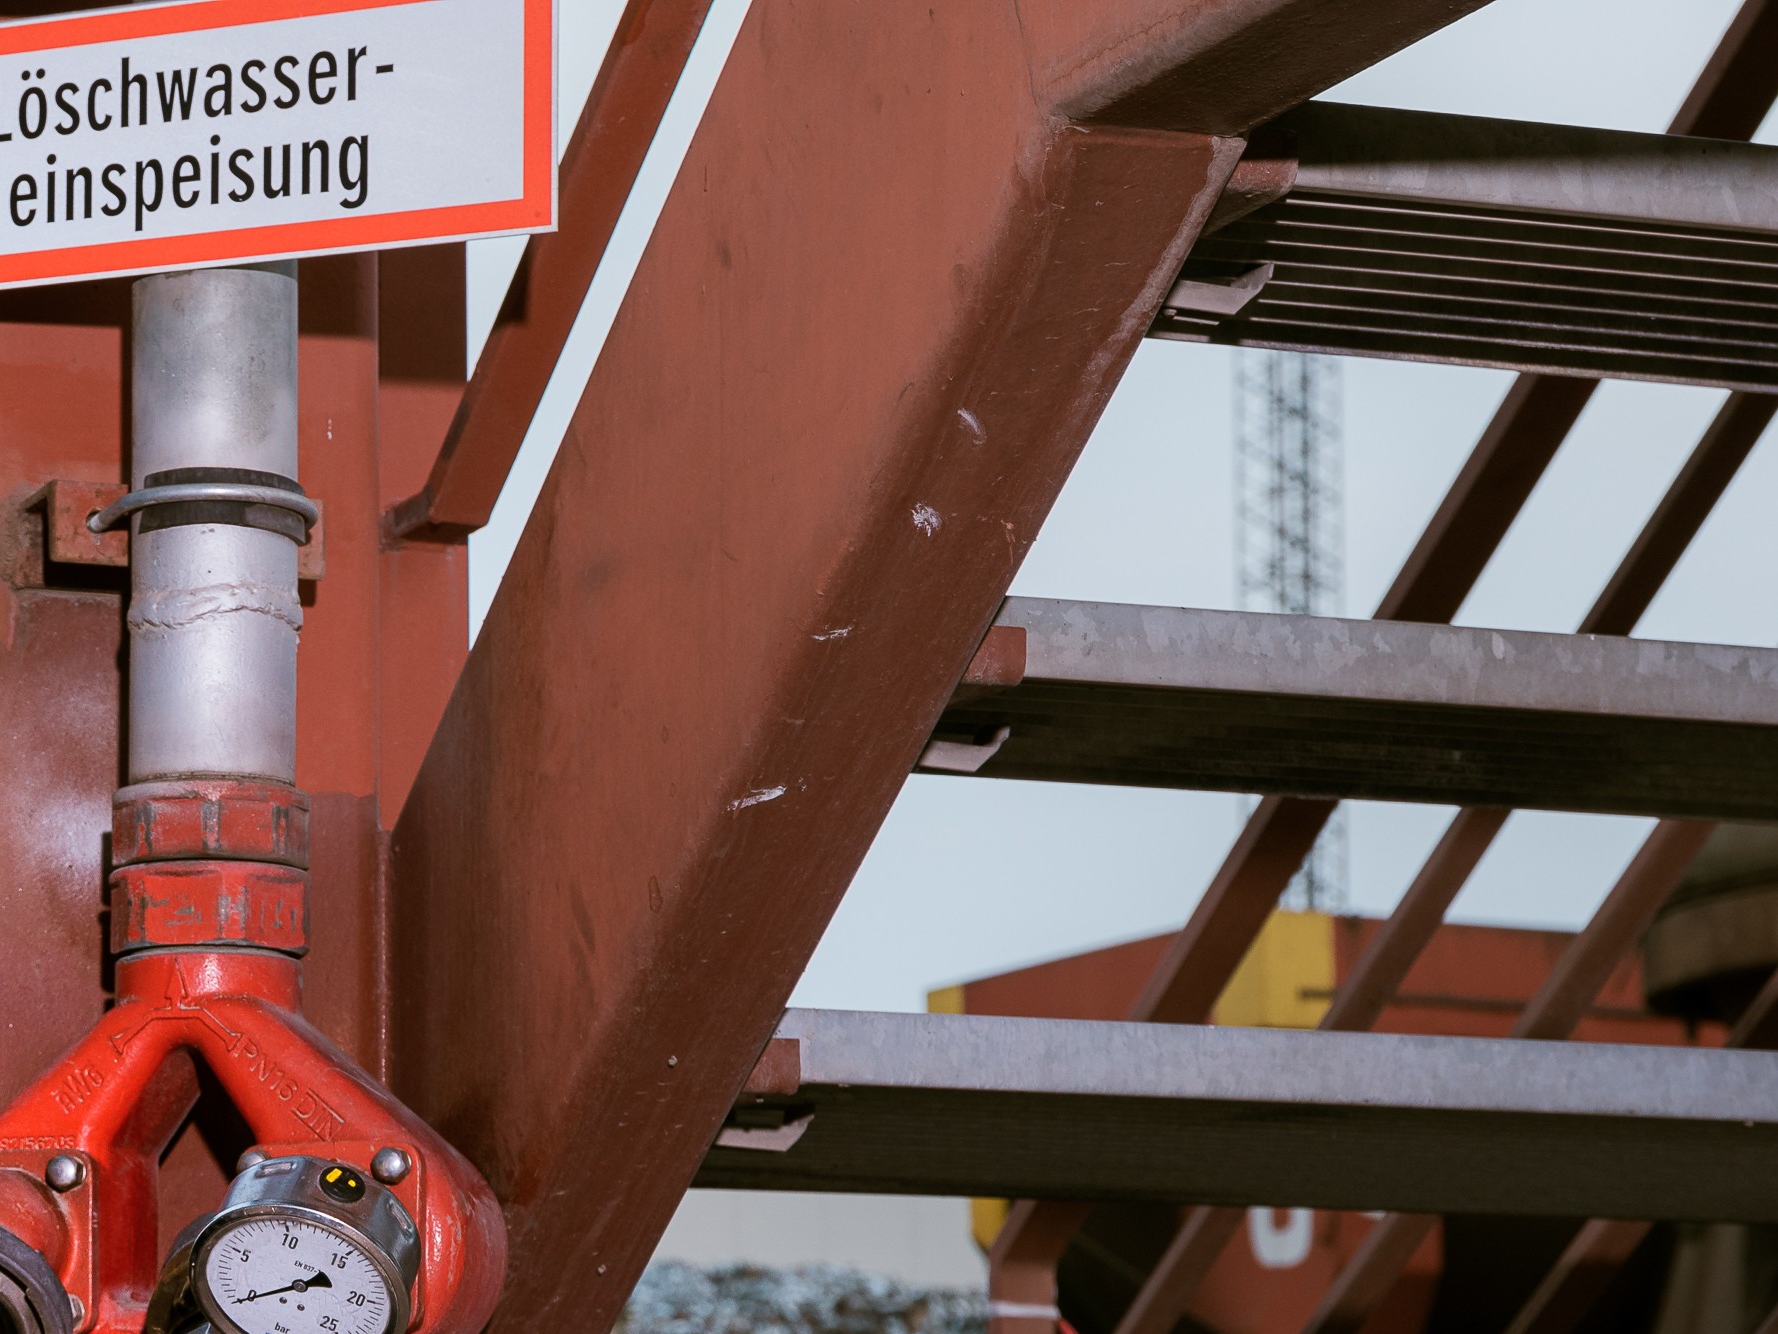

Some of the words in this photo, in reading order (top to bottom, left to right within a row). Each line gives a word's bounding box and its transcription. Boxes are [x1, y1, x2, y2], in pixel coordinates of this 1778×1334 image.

[8, 134, 371, 231] einspeisung
[282, 1233, 299, 1250] 10
[240, 1250, 252, 1262] 5
[330, 1252, 349, 1269] 15
[347, 1291, 366, 1307] 20
[274, 1322, 291, 1334] bar
[319, 1315, 339, 1332] 25
